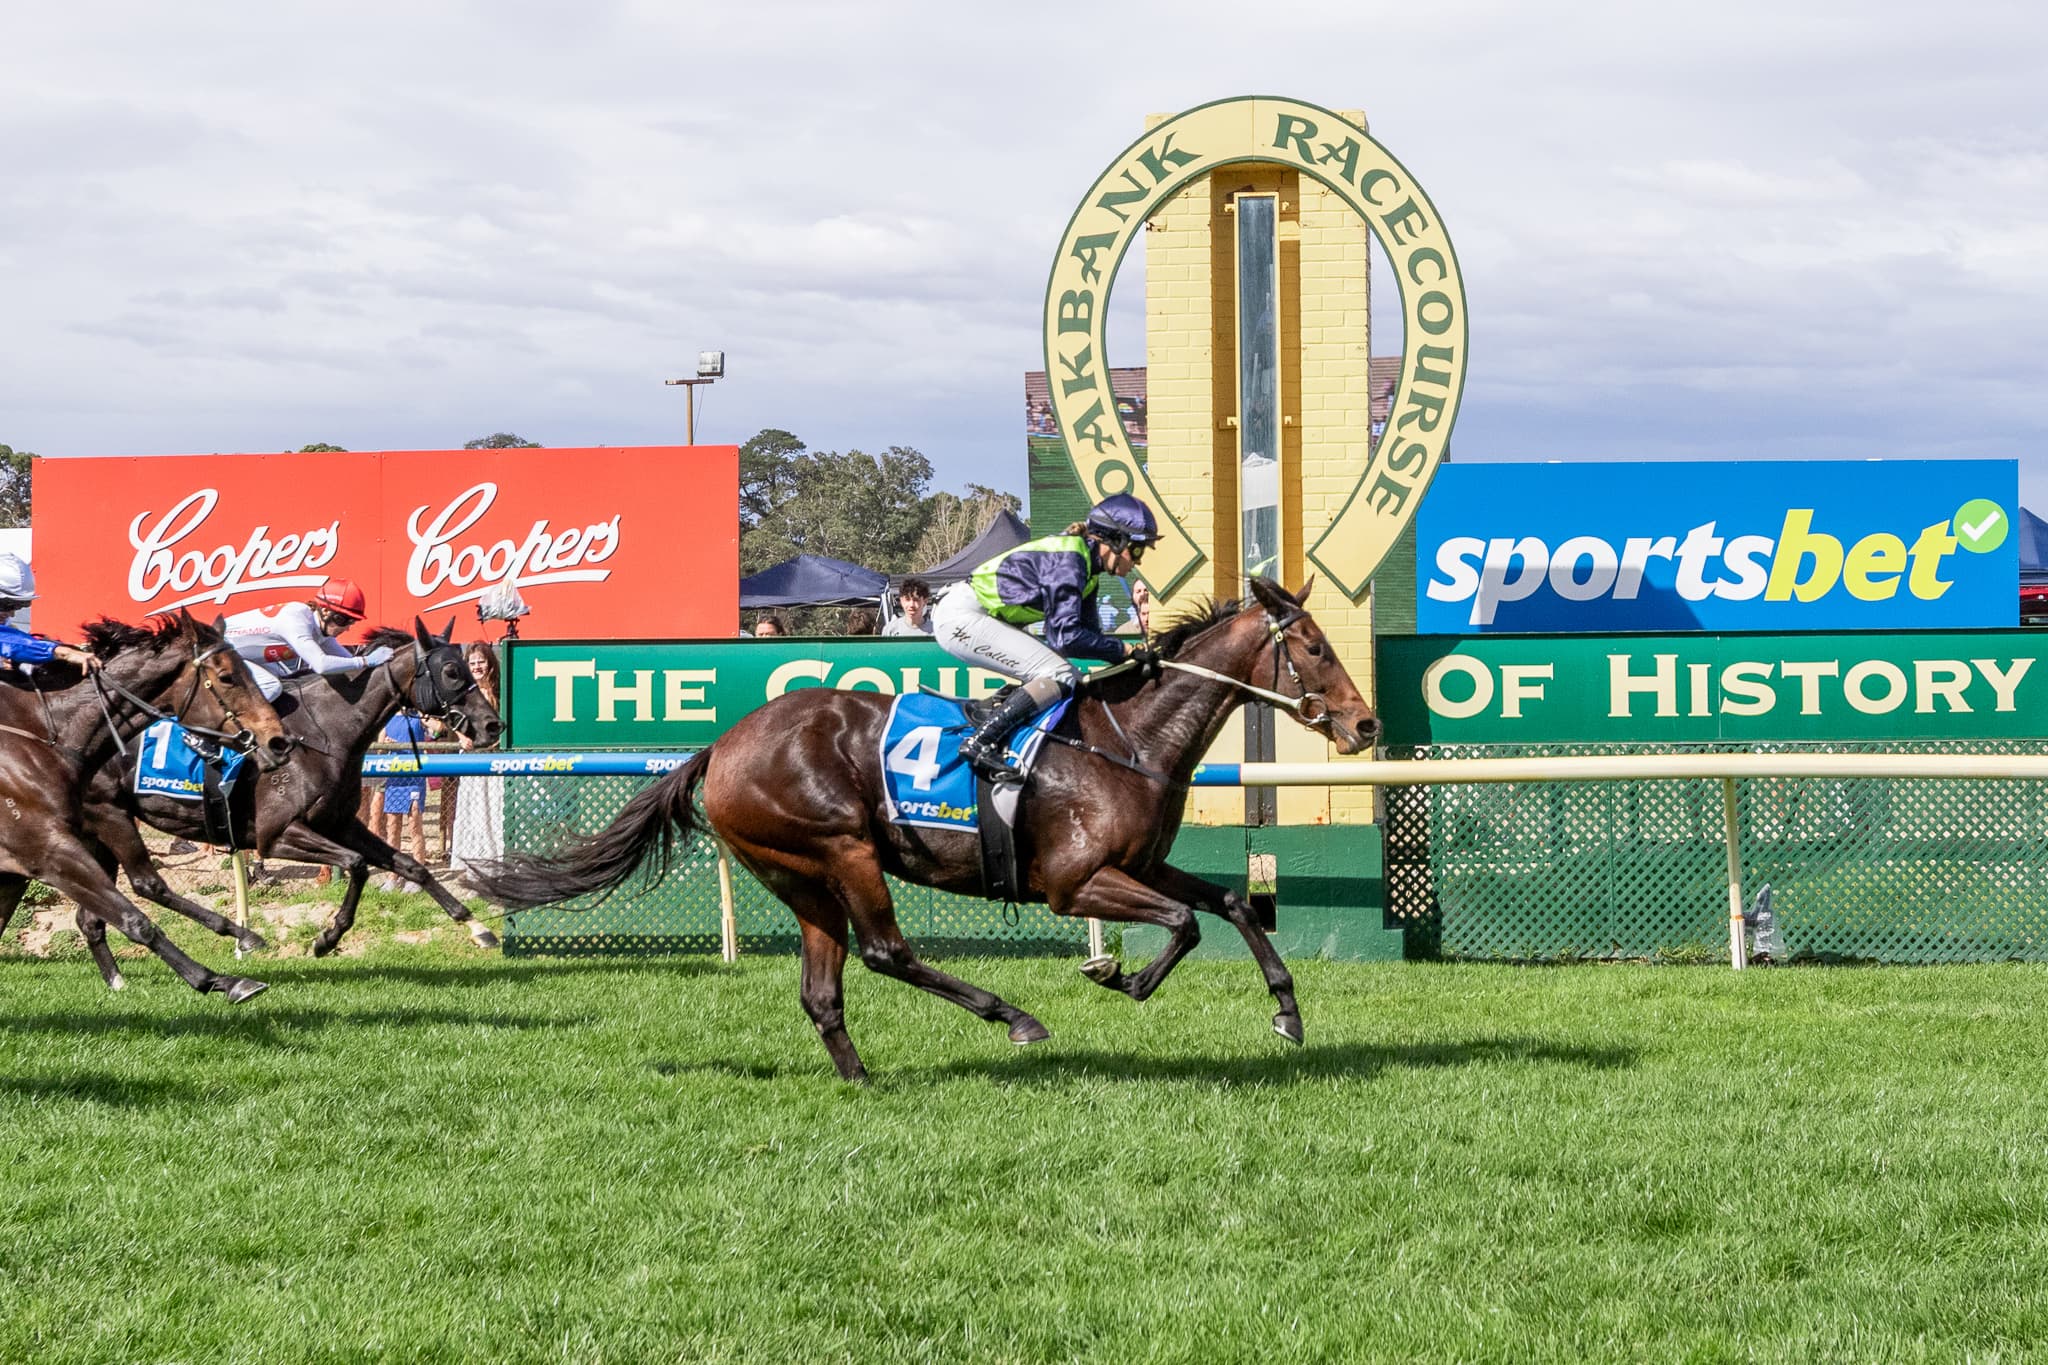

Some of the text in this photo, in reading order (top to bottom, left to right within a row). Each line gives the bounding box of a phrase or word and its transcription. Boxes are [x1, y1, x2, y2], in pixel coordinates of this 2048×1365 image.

[1058, 112, 1455, 517] OAKBANK RACECOURSE
[128, 487, 340, 605] Coopers
[406, 481, 621, 598] Coopers
[1425, 508, 1959, 626] sportsbet
[765, 659, 1108, 701] COUR
[973, 644, 1020, 668] Collett
[147, 721, 174, 769] 1
[361, 755, 420, 773] rtsbet
[490, 755, 576, 774] sportsbet
[886, 725, 944, 791] 4
[894, 800, 973, 822] ortsbet
